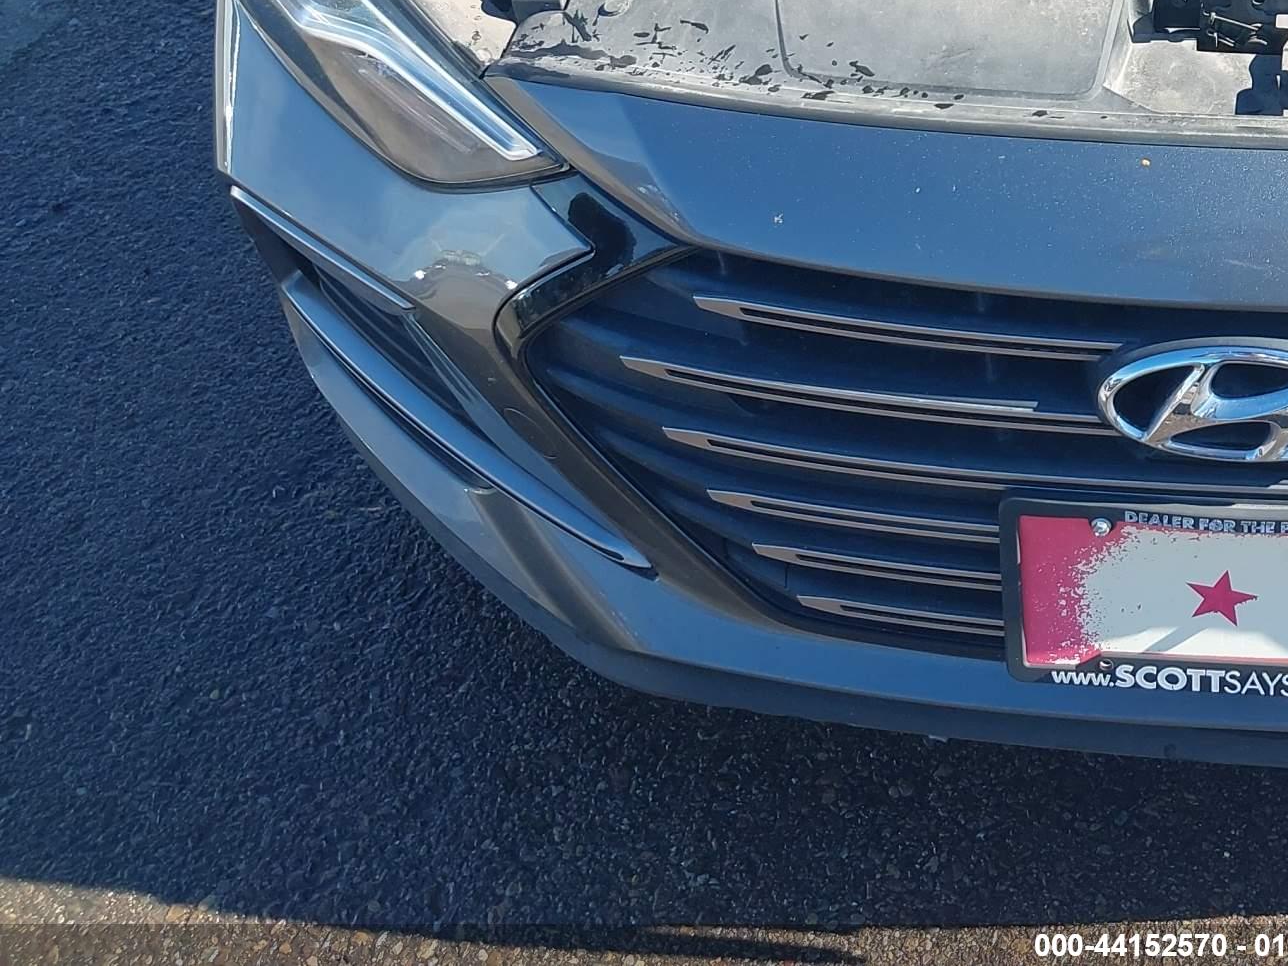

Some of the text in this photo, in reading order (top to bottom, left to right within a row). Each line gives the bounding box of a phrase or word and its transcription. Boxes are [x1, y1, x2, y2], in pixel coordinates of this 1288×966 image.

[1125, 511, 1194, 529] DEALER
[1199, 518, 1236, 533] FOR
[1240, 520, 1275, 533] THE
